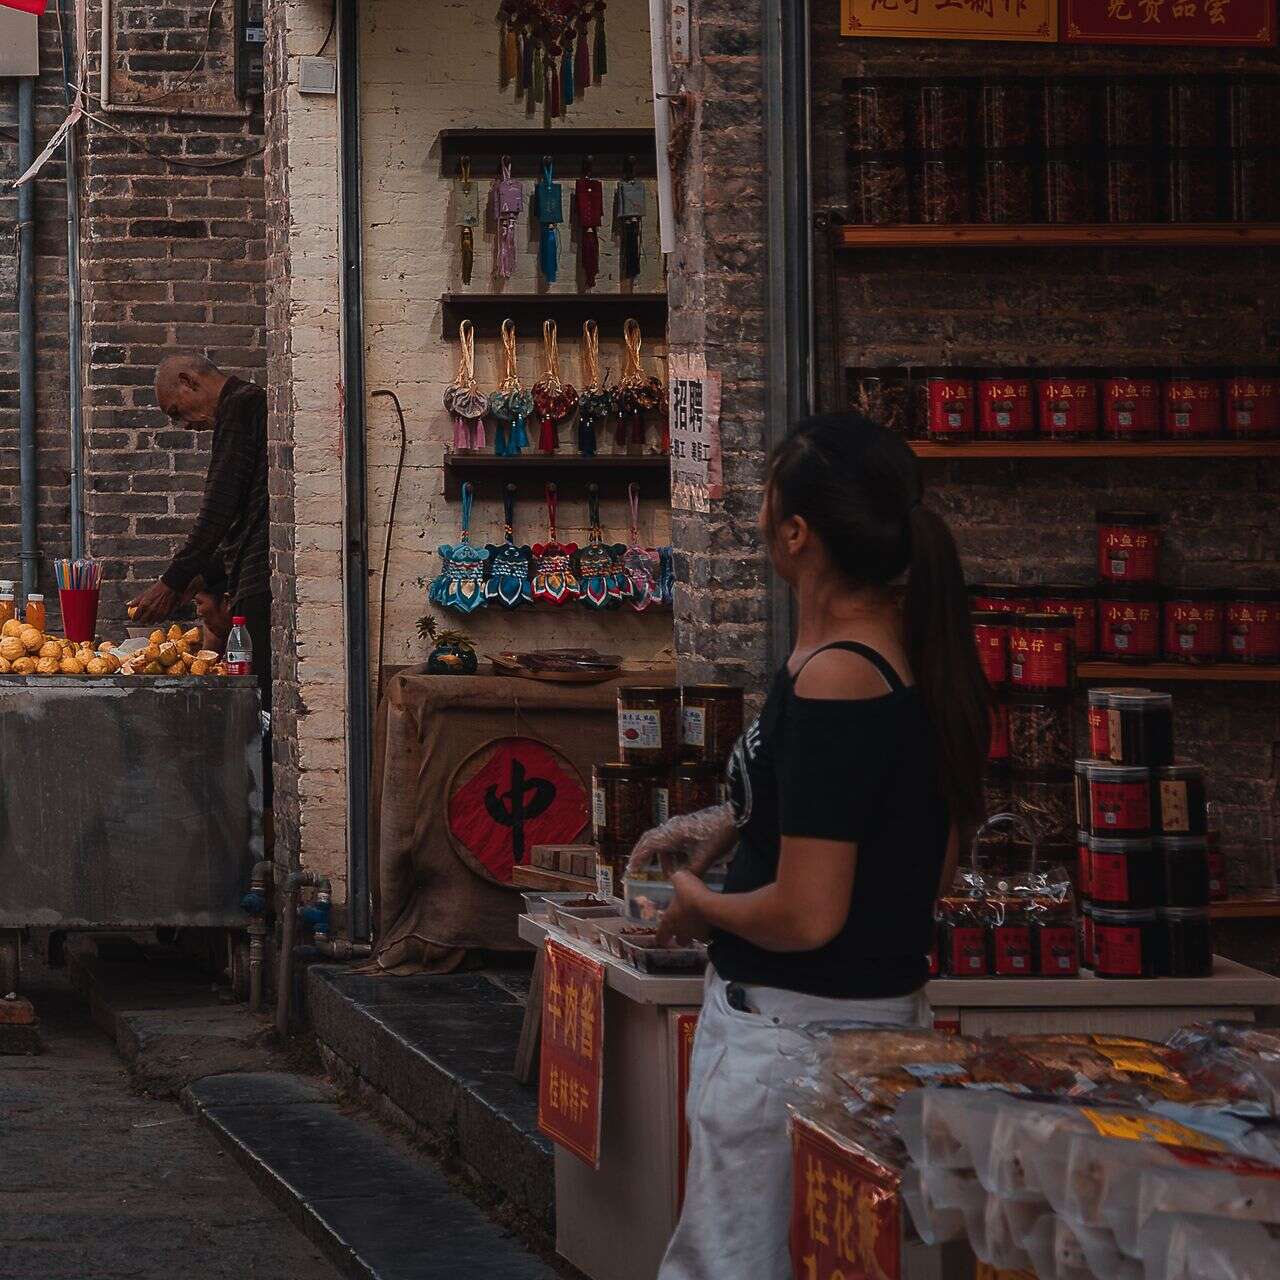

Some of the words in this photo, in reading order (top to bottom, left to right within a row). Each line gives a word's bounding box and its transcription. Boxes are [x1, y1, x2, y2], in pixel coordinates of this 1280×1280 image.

[988, 385, 1029, 399] 小鱼仔
[1046, 385, 1088, 399] 小鱼仔
[1111, 385, 1152, 399] 小鱼仔
[1168, 385, 1210, 399] 小鱼仔
[1231, 385, 1273, 399] 小鱼仔
[673, 377, 703, 433] 招聘
[1106, 533, 1149, 548] 小鱼仔
[1109, 606, 1151, 622] 小鱼仔
[1174, 606, 1216, 622] 小鱼仔
[1227, 606, 1267, 622] 小鱼仔
[484, 756, 557, 864] 中
[548, 968, 594, 1061] 牛肉酱
[550, 1063, 590, 1123] 桂林特产
